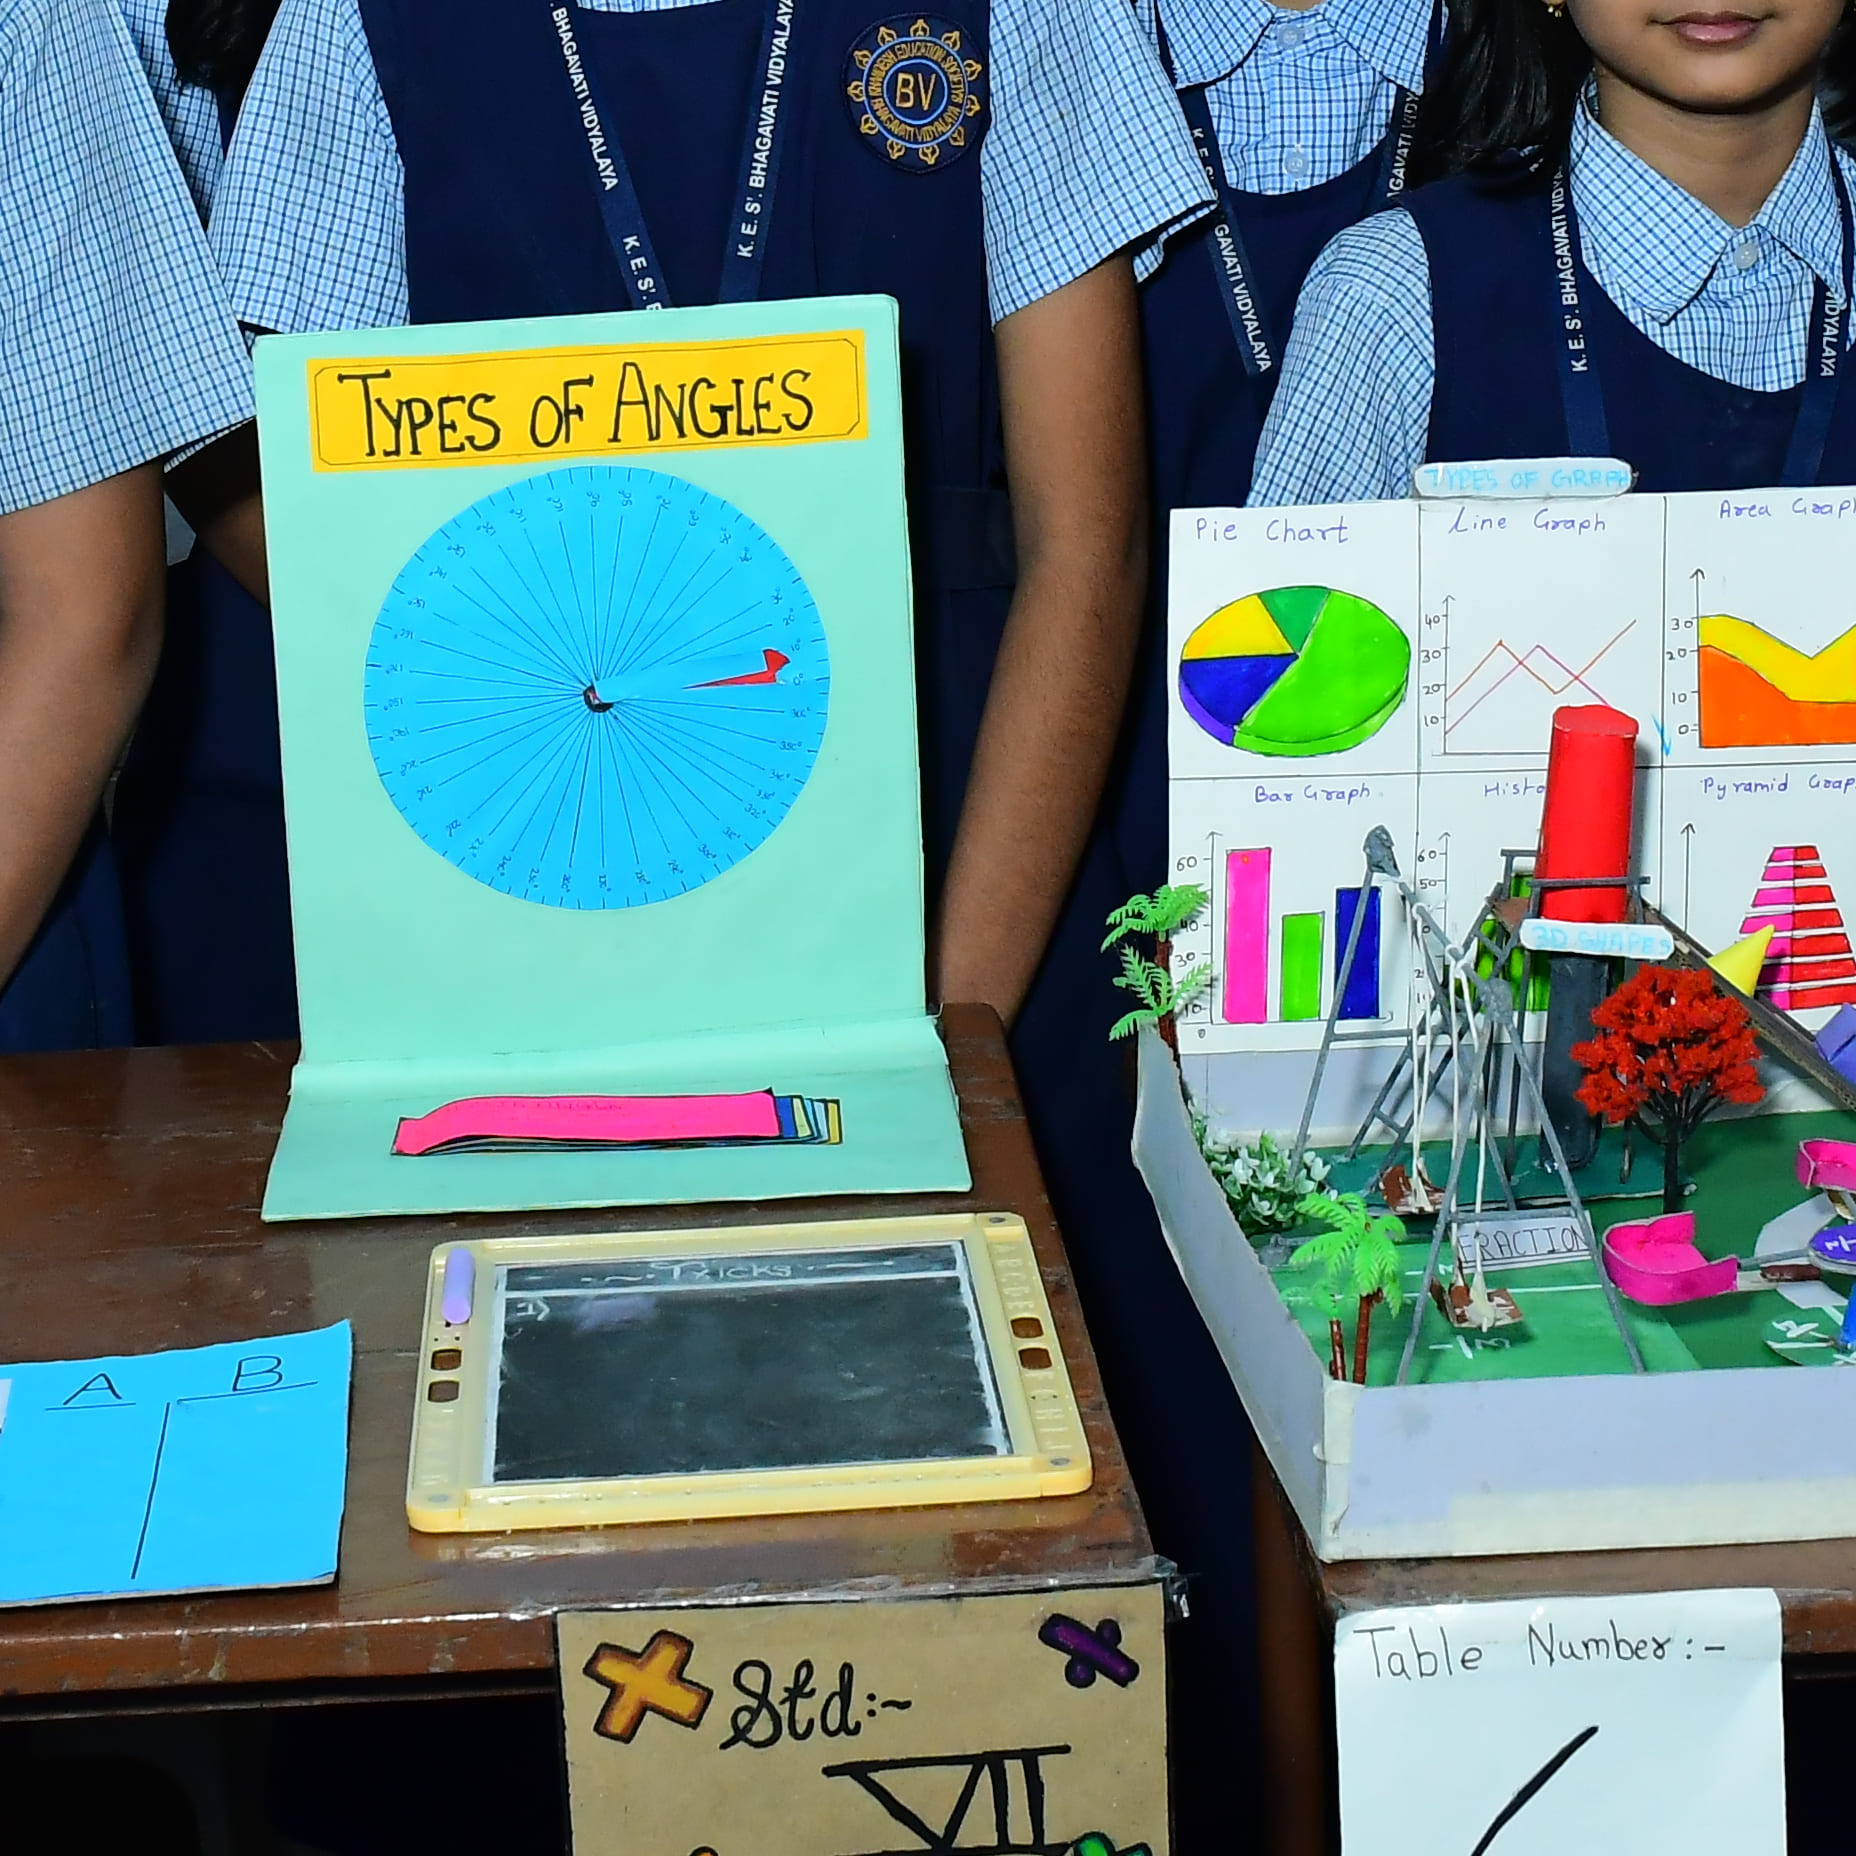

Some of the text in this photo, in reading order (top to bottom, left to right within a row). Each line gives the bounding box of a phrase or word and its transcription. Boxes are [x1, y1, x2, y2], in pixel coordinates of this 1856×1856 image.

[895, 72, 937, 111] BV
[749, 90, 780, 189] BHAGAVATI
[529, 373, 594, 448] OF
[1448, 509, 1607, 539] Line Graph
[1719, 499, 1772, 520] Area
[1195, 516, 1350, 544] Pie Chart
[1254, 783, 1371, 807] Bar Graph
[1700, 775, 1790, 797] Pyramid
[1460, 1225, 1586, 1263] FRACTION
[63, 1356, 284, 1405] A B
[1352, 1624, 1482, 1682] Table
[823, 1745, 1073, 1856] VII
